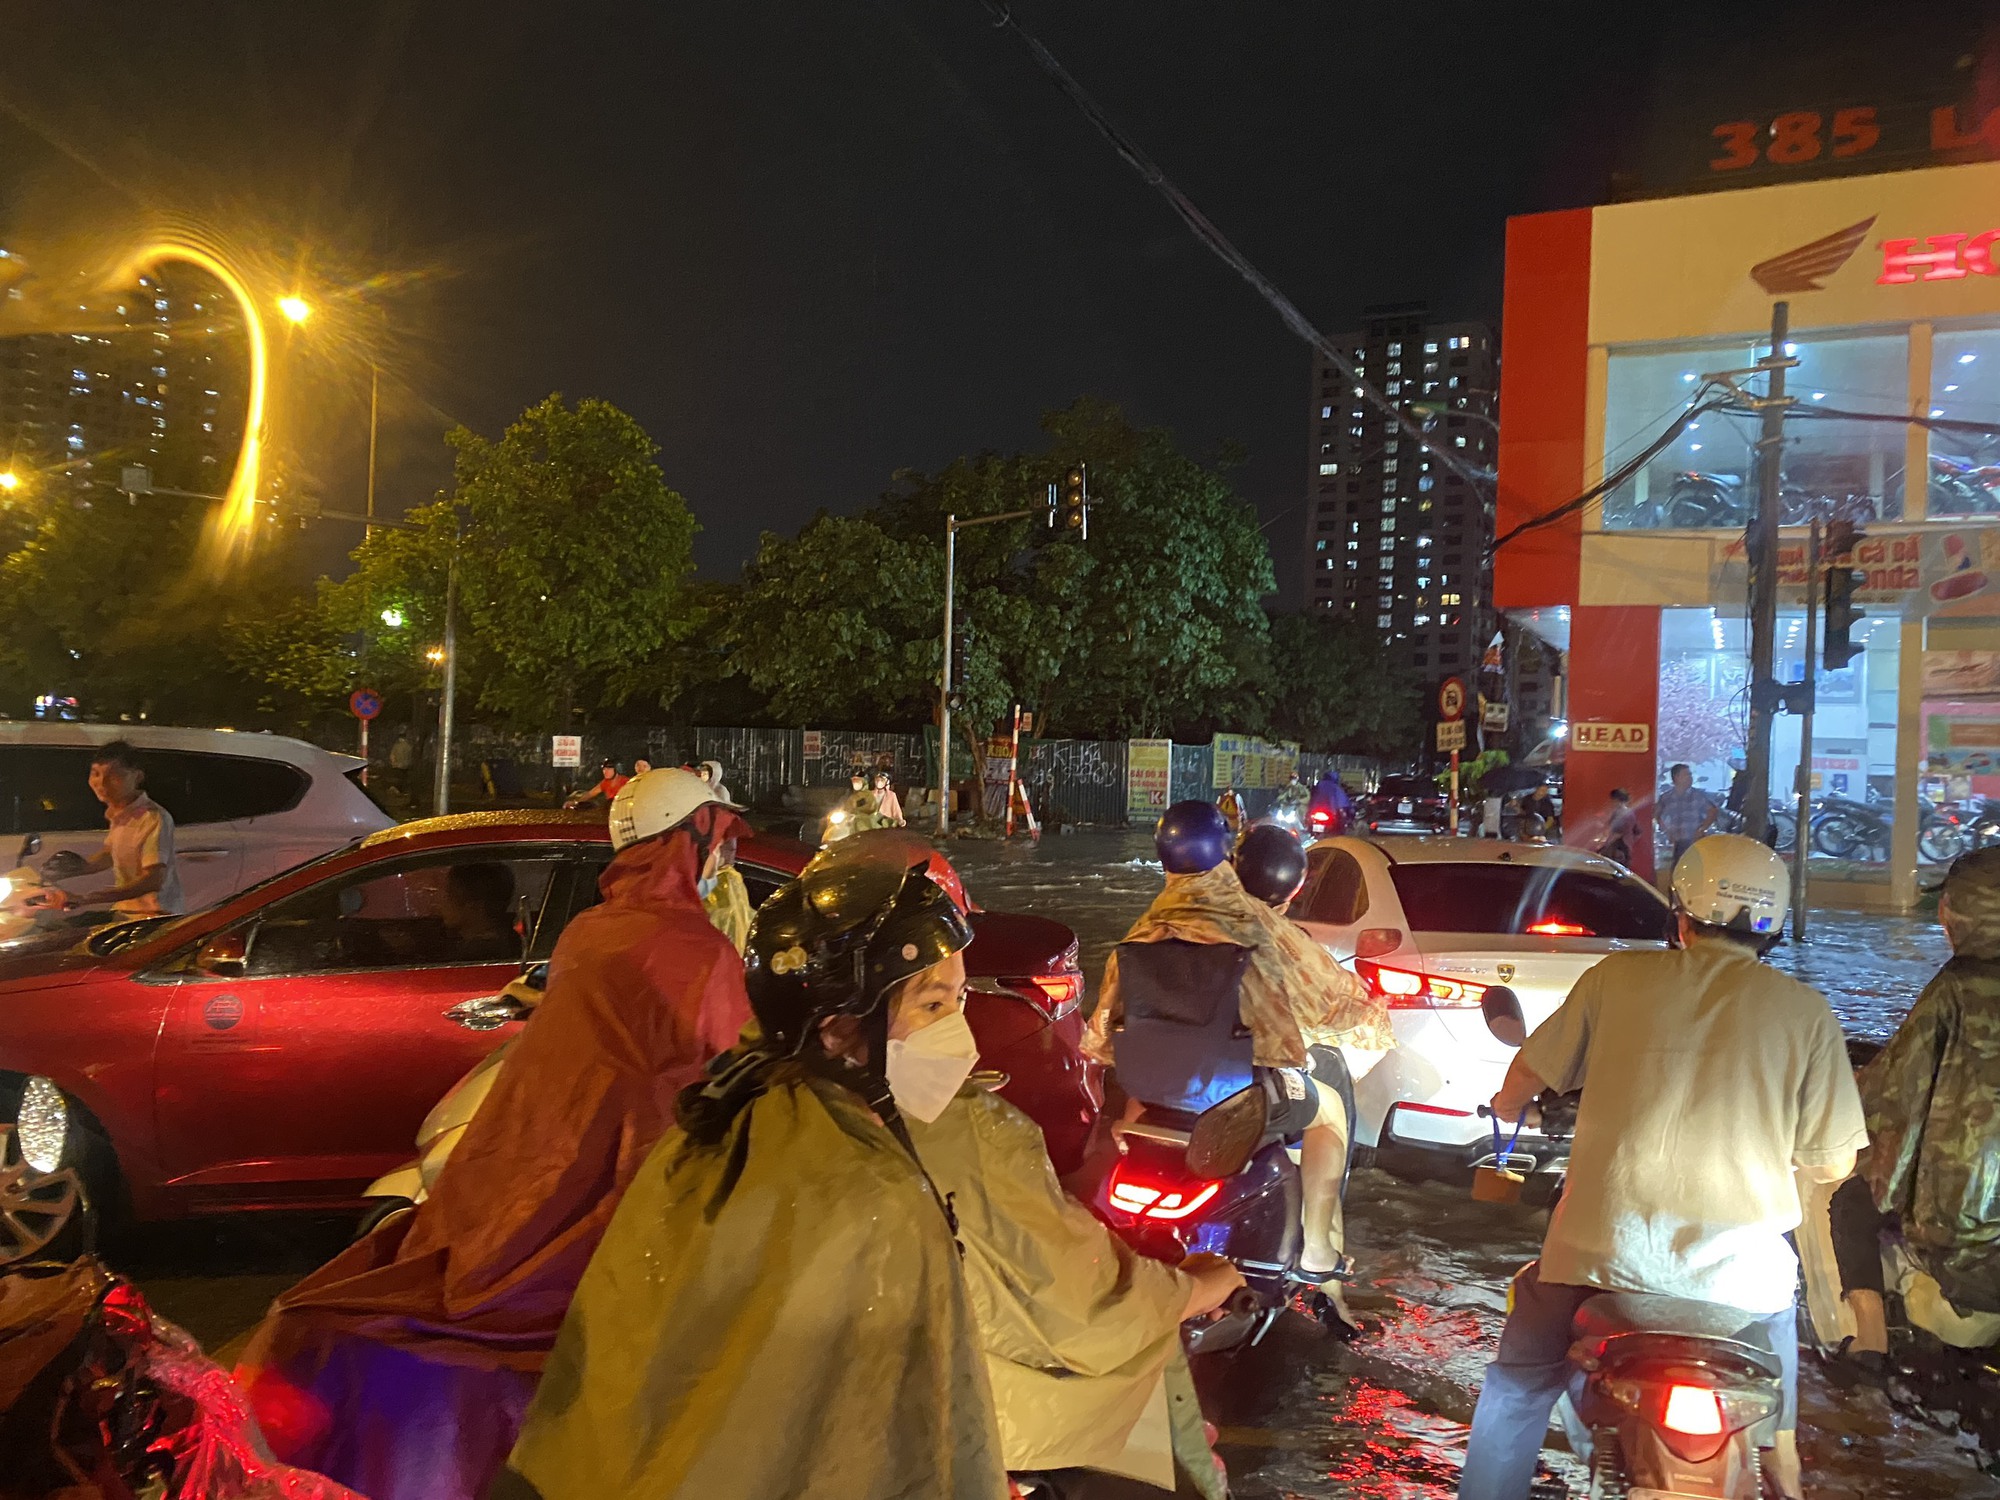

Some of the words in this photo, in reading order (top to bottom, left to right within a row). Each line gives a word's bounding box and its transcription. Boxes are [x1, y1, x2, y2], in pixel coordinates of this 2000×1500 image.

[1710, 106, 1881, 171] 385
[1931, 105, 2000, 150] L
[1577, 727, 1644, 743] HEAD
